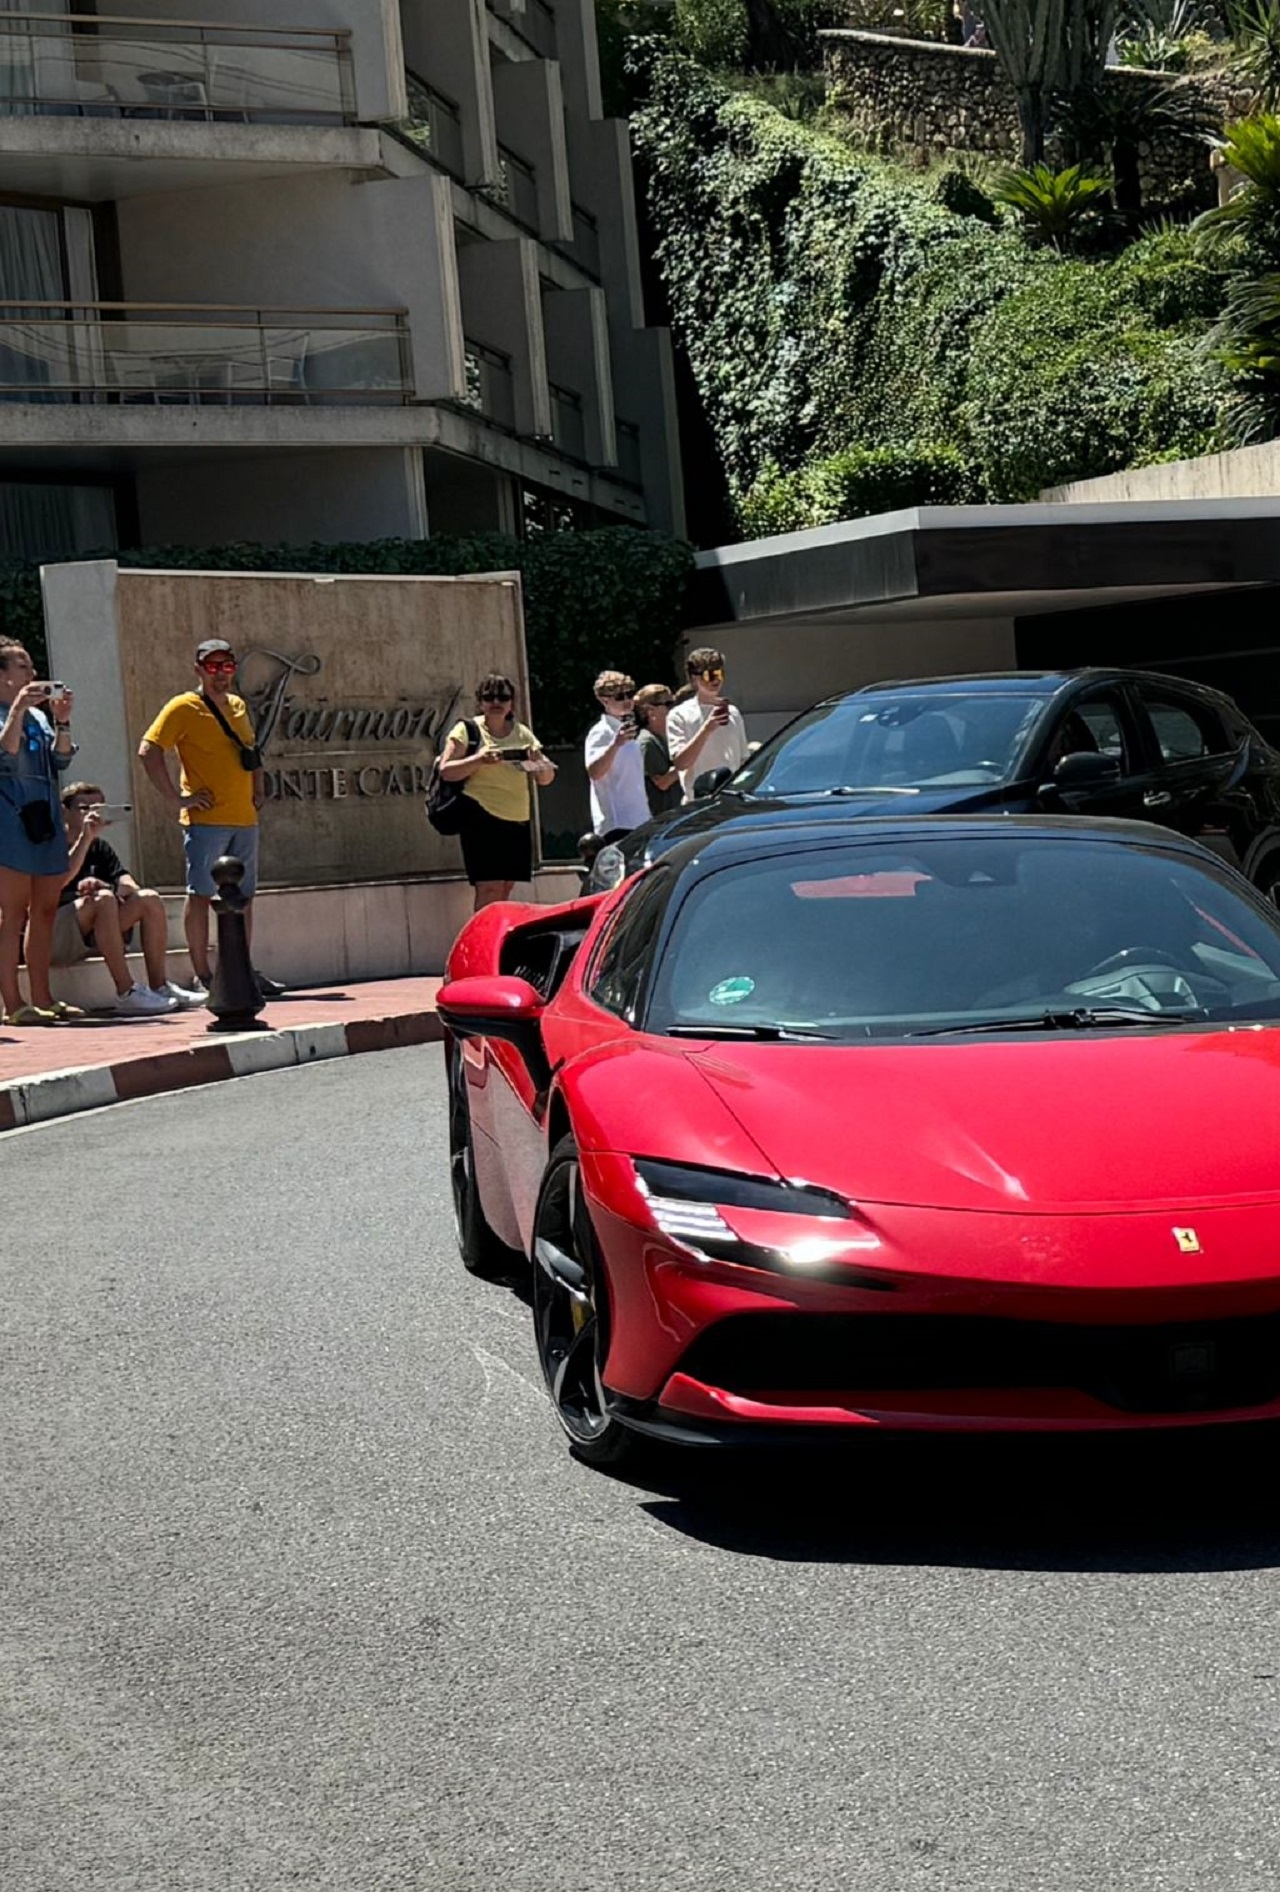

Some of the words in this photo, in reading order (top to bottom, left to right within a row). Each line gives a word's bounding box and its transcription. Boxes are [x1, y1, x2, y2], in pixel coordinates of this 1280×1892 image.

[236, 650, 463, 753] Fairmont
[264, 768, 347, 800] ONTE
[358, 765, 429, 797] CAR
